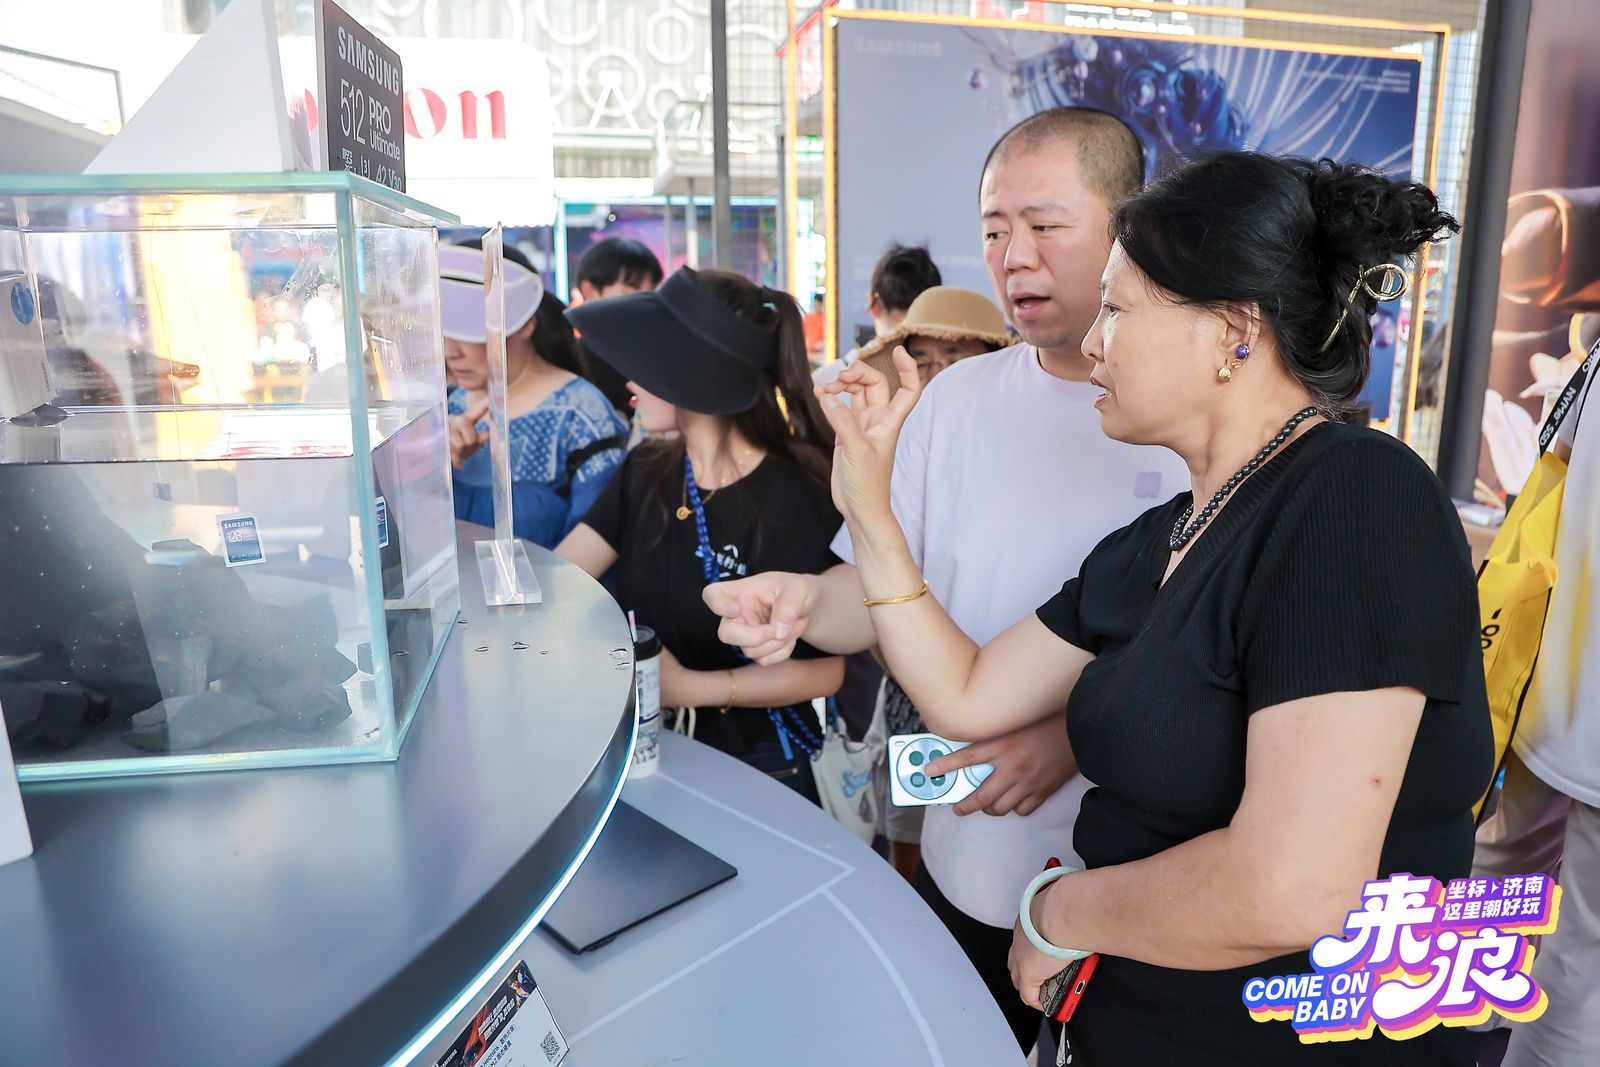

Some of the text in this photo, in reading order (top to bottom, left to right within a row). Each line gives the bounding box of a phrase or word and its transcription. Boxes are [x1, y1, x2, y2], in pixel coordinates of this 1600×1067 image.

[338, 26, 399, 95] SAMSUNG
[340, 79, 391, 145] 512 PRO
[369, 128, 400, 160] Ultimate
[1540, 423, 1554, 446] SSD
[224, 520, 253, 529] SAMSUNG
